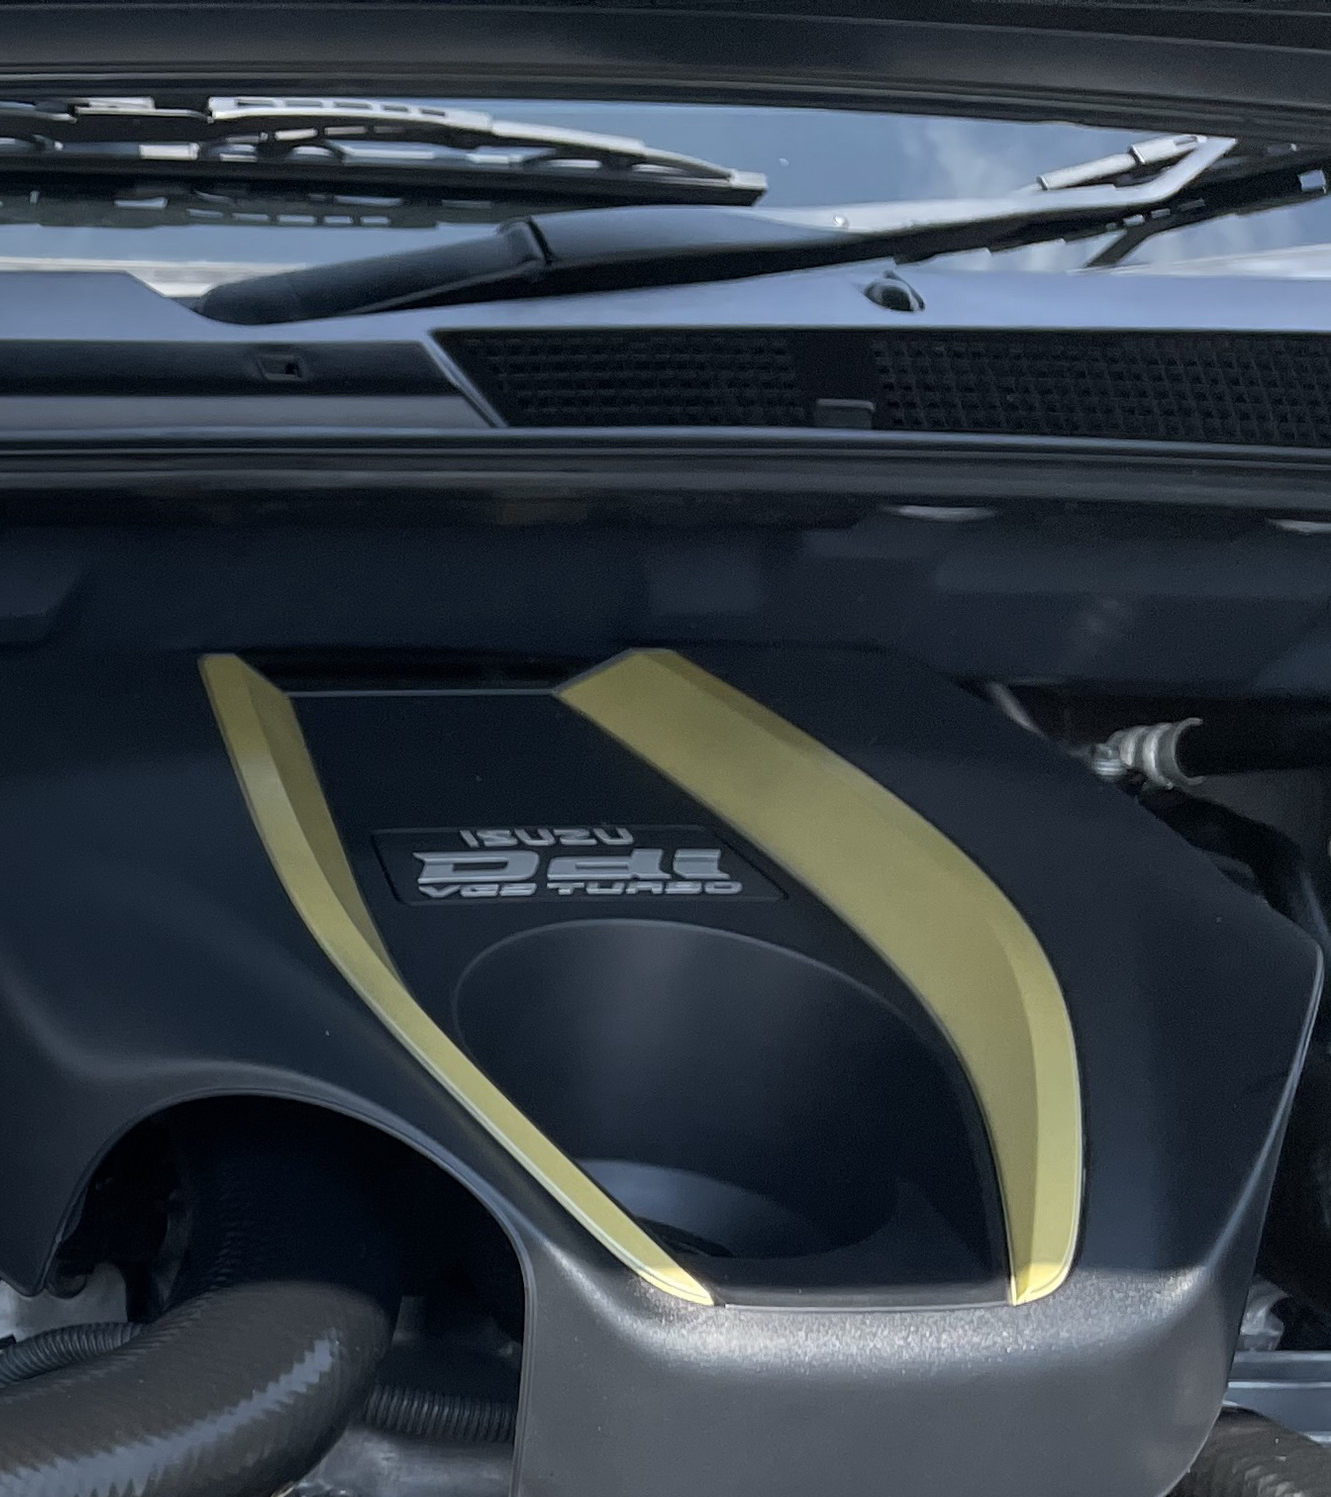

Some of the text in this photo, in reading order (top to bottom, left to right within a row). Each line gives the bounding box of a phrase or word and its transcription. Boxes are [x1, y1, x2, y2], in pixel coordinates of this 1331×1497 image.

[458, 827, 636, 849] ISUZU
[417, 880, 744, 899] VGS TURBO
